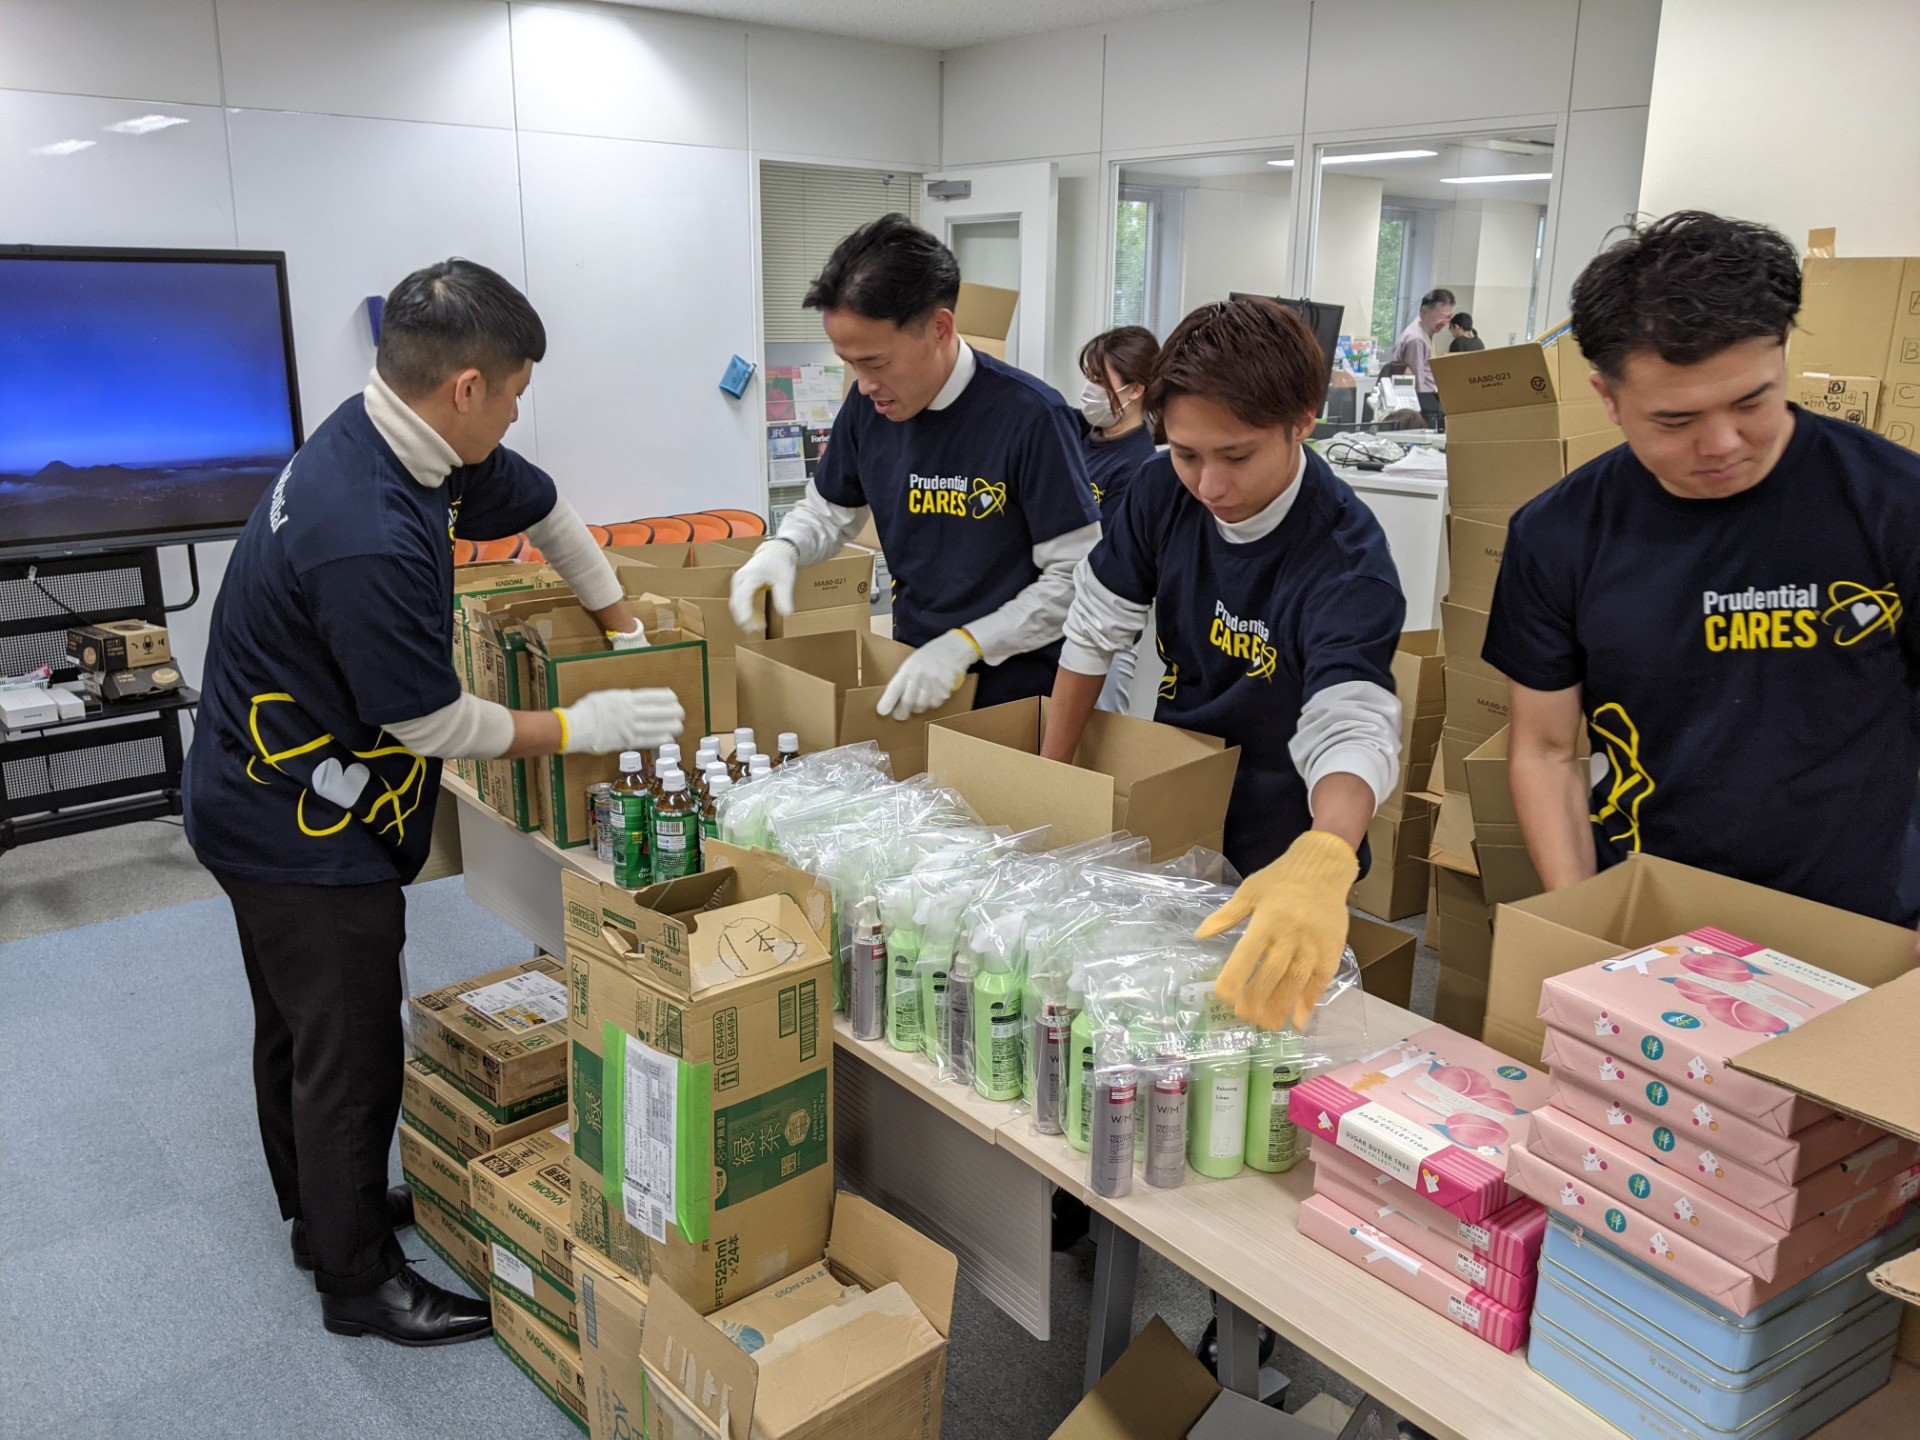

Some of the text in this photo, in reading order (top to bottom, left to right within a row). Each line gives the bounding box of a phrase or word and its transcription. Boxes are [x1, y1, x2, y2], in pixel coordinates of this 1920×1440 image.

[1904, 342, 1919, 360] B
[1468, 372, 1511, 385] MA80-021
[1899, 386, 1915, 400] C
[771, 428, 785, 438] JFC
[1889, 424, 1907, 440] D
[909, 473, 968, 493] Prudential
[908, 489, 968, 517] CARES
[495, 578, 524, 588] KAGOME
[1703, 583, 1818, 615] Prudential
[1214, 599, 1270, 643] Prudentia
[1704, 609, 1818, 652] CARES
[1209, 618, 1262, 663] CARE
[1477, 698, 1508, 713] MA80-0
[1765, 953, 1828, 980] COLLECTION
[715, 1015, 726, 1060] A:64494
[727, 1011, 736, 1057] B:64494
[428, 1095, 458, 1123] KAGOME
[1111, 1114, 1132, 1124] W/M
[1156, 1104, 1179, 1114] W/M
[1358, 1111, 1430, 1151] SAND COLLECTION
[1345, 1131, 1411, 1171] SUGAR BUTTER TREE
[1353, 1143, 1401, 1173] SAND COLLECTION
[431, 1157, 461, 1186] KAGOME
[484, 1157, 511, 1175] 4289
[544, 1168, 571, 1190] 保存用
[528, 1179, 567, 1206] KAGOME
[441, 1214, 467, 1246] KAGOME
[507, 1200, 542, 1234] KAGOME
[728, 1233, 740, 1277] ×24本
[715, 1238, 728, 1308] PET525ml
[525, 1327, 557, 1365] KAGOME
